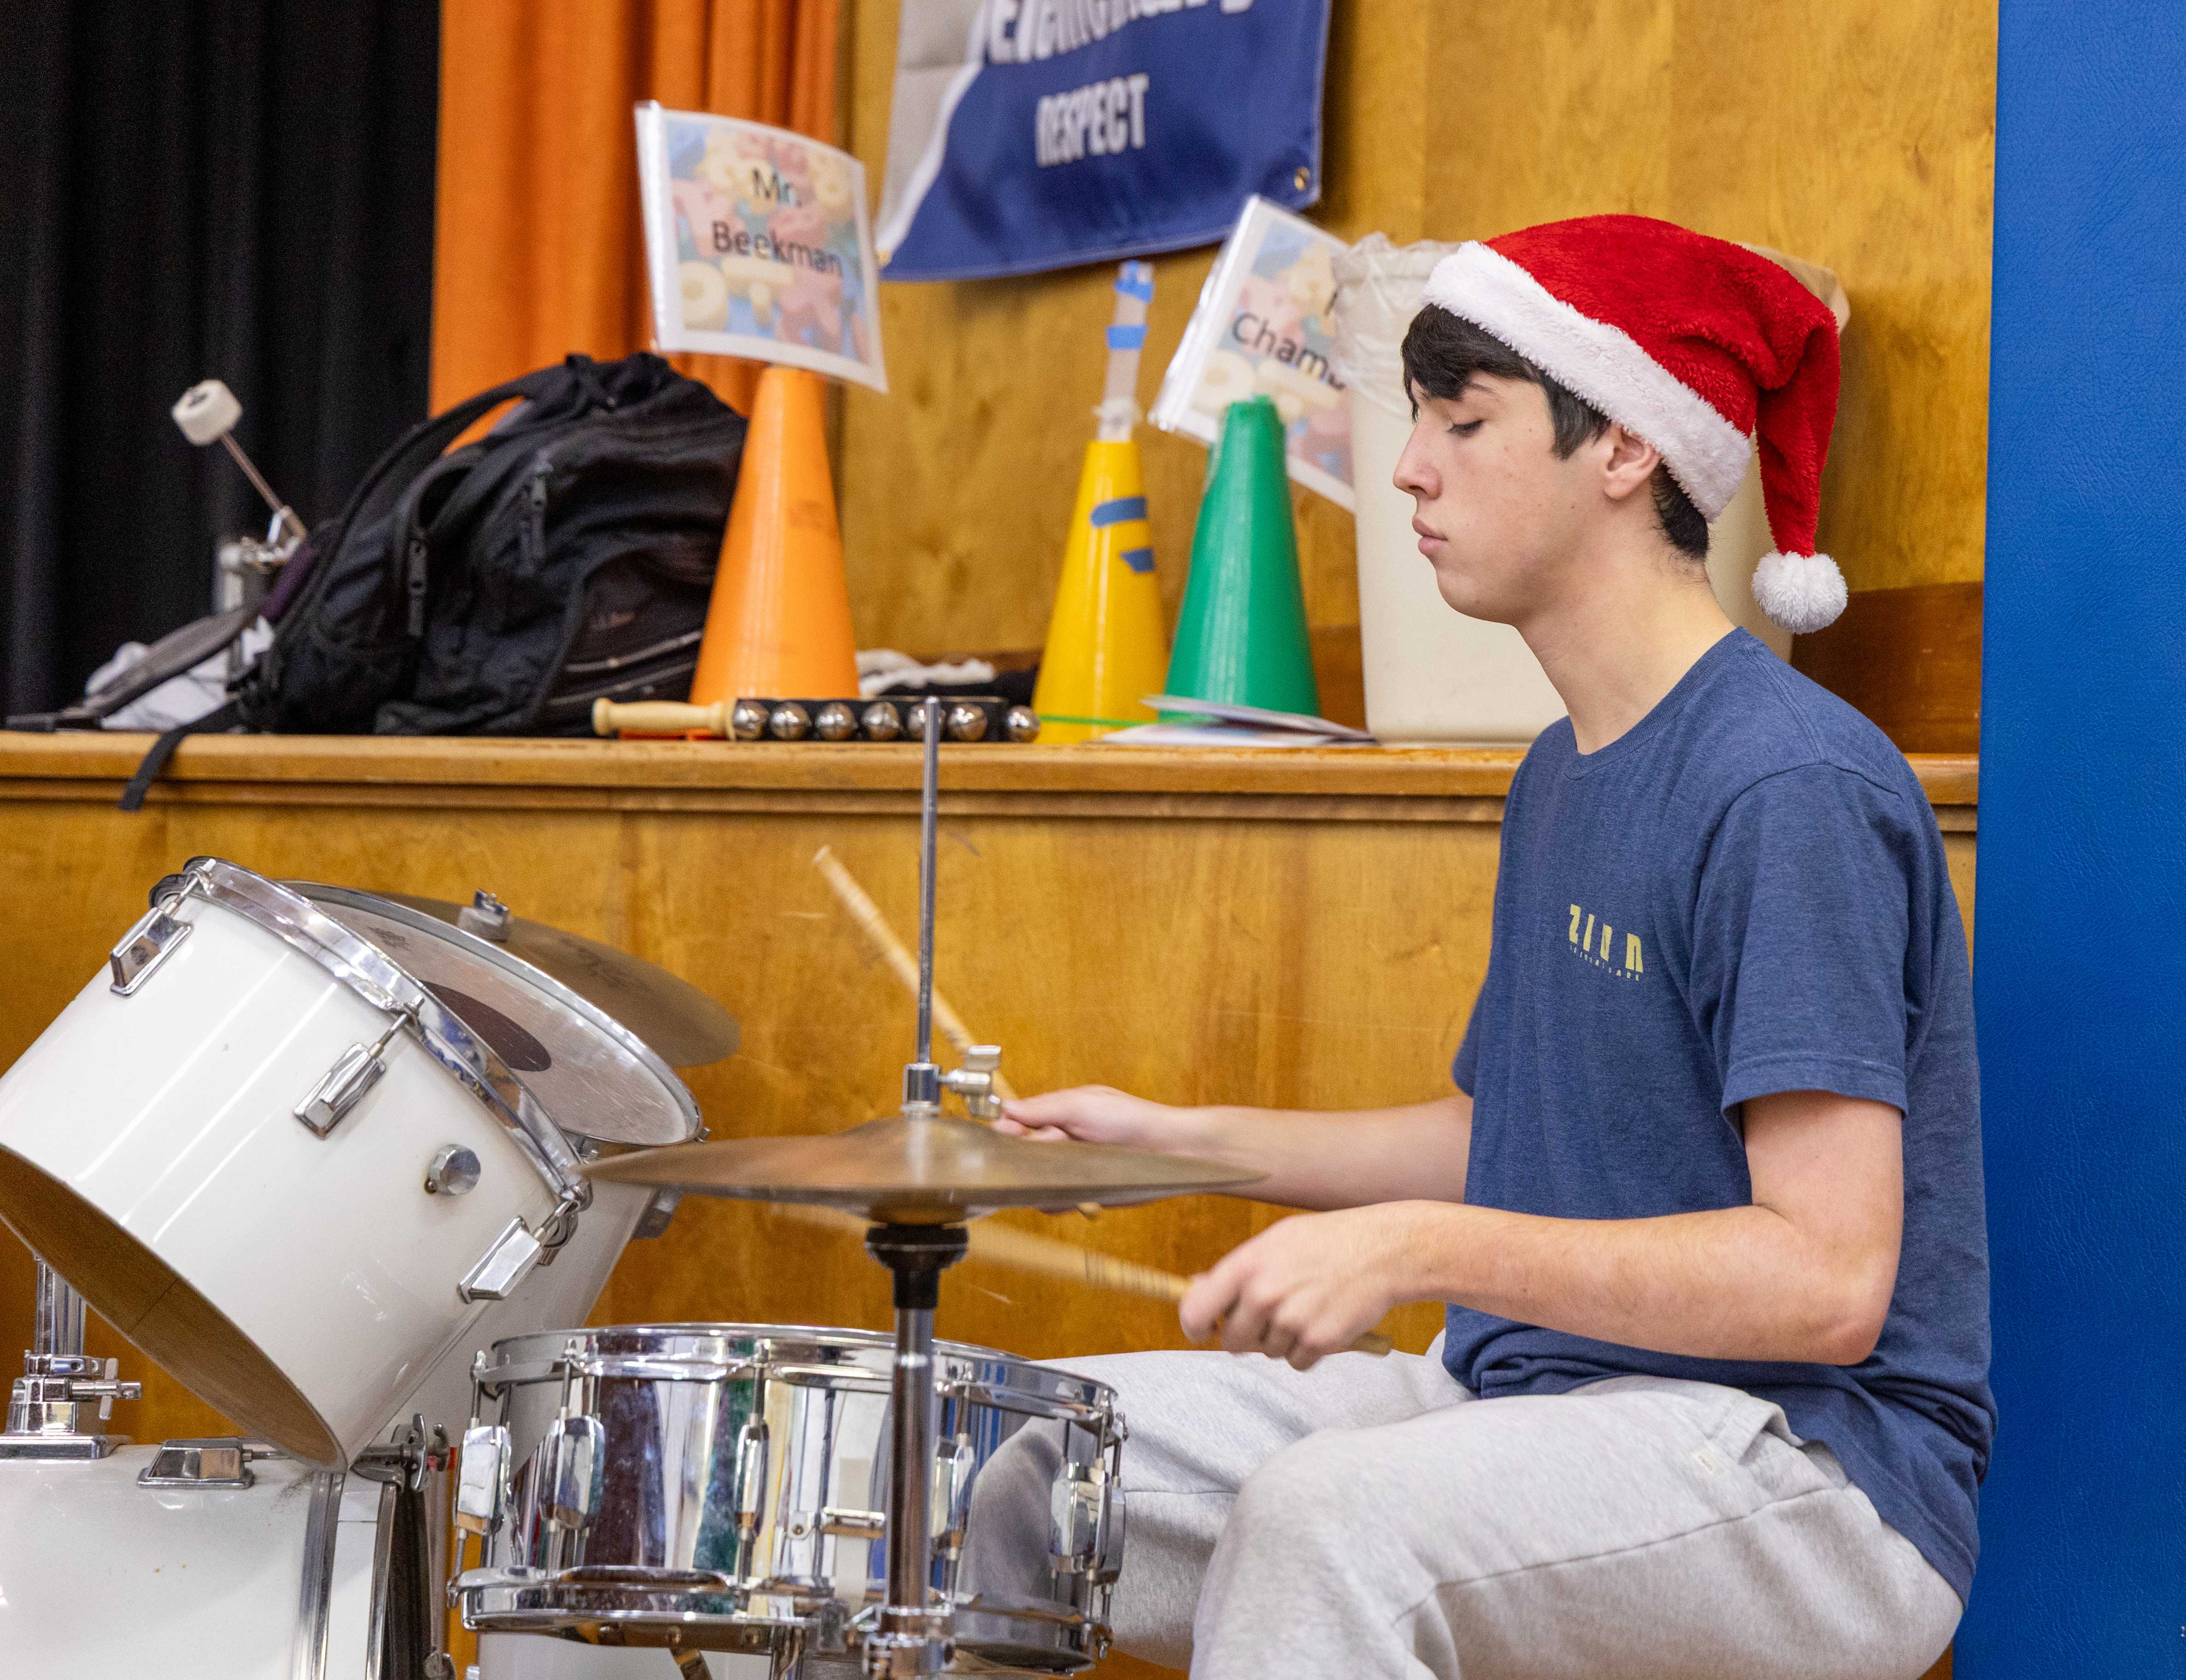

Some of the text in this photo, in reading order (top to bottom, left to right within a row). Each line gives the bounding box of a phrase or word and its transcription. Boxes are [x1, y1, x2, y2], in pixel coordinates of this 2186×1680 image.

[1035, 73, 1149, 167] RESPECT
[751, 168, 802, 208] Mr.
[712, 220, 843, 277] Beekman
